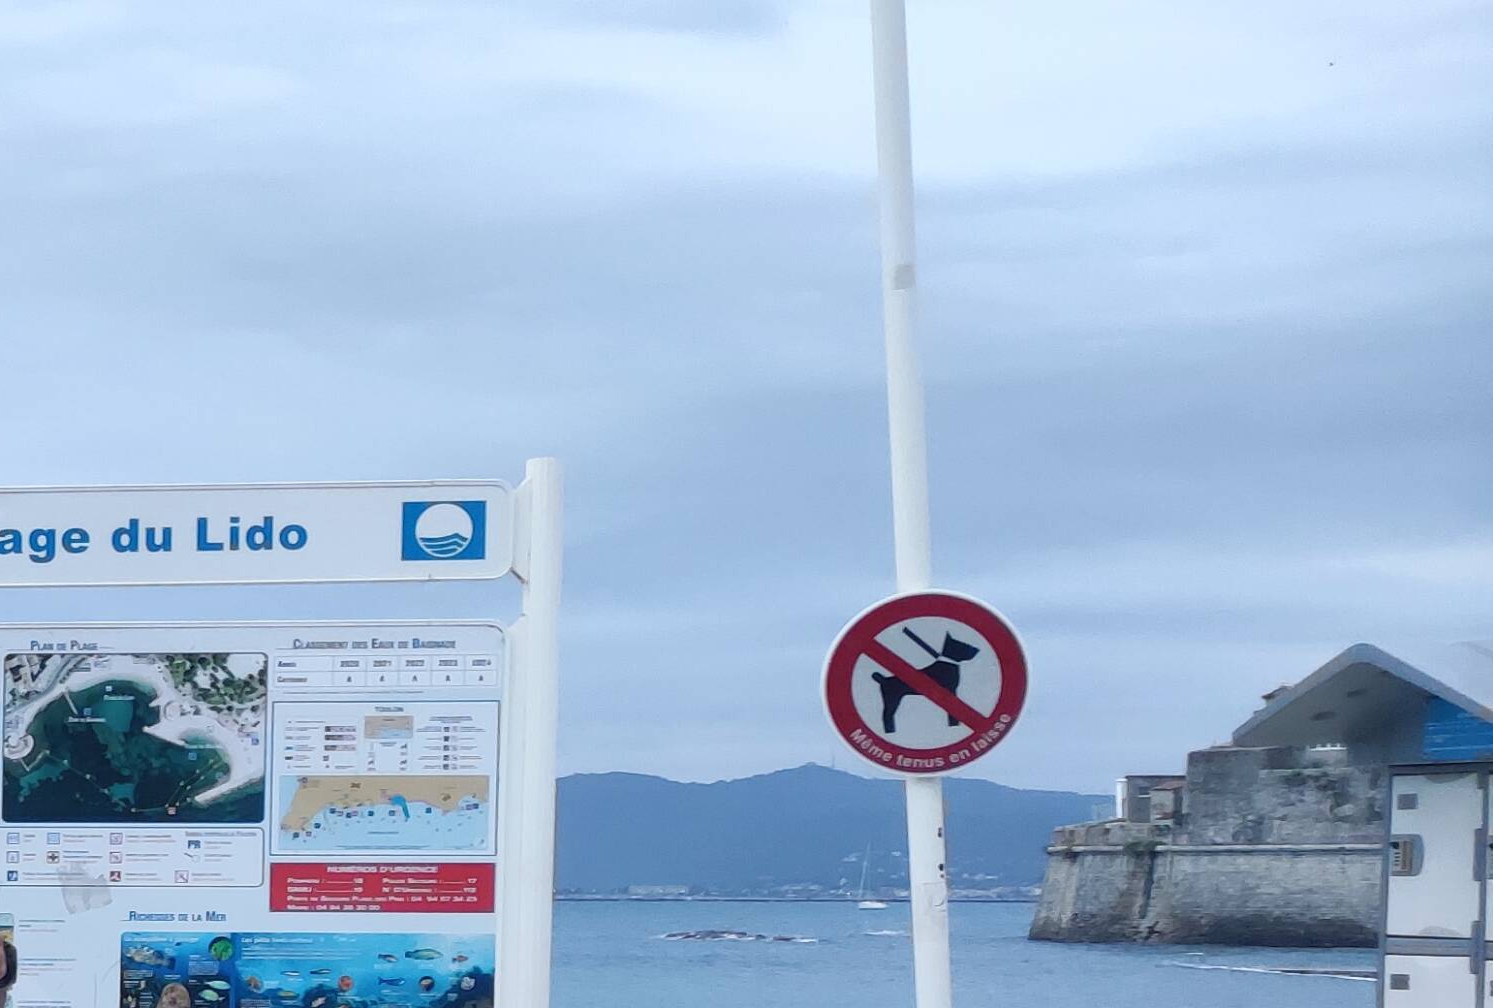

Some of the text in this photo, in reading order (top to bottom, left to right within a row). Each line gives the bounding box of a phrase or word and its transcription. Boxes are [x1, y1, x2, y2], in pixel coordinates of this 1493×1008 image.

[112, 518, 173, 553] du
[196, 515, 308, 552] Lido
[896, 754, 945, 768] tenus
[948, 748, 970, 763] en
[970, 713, 1011, 752] laisse
